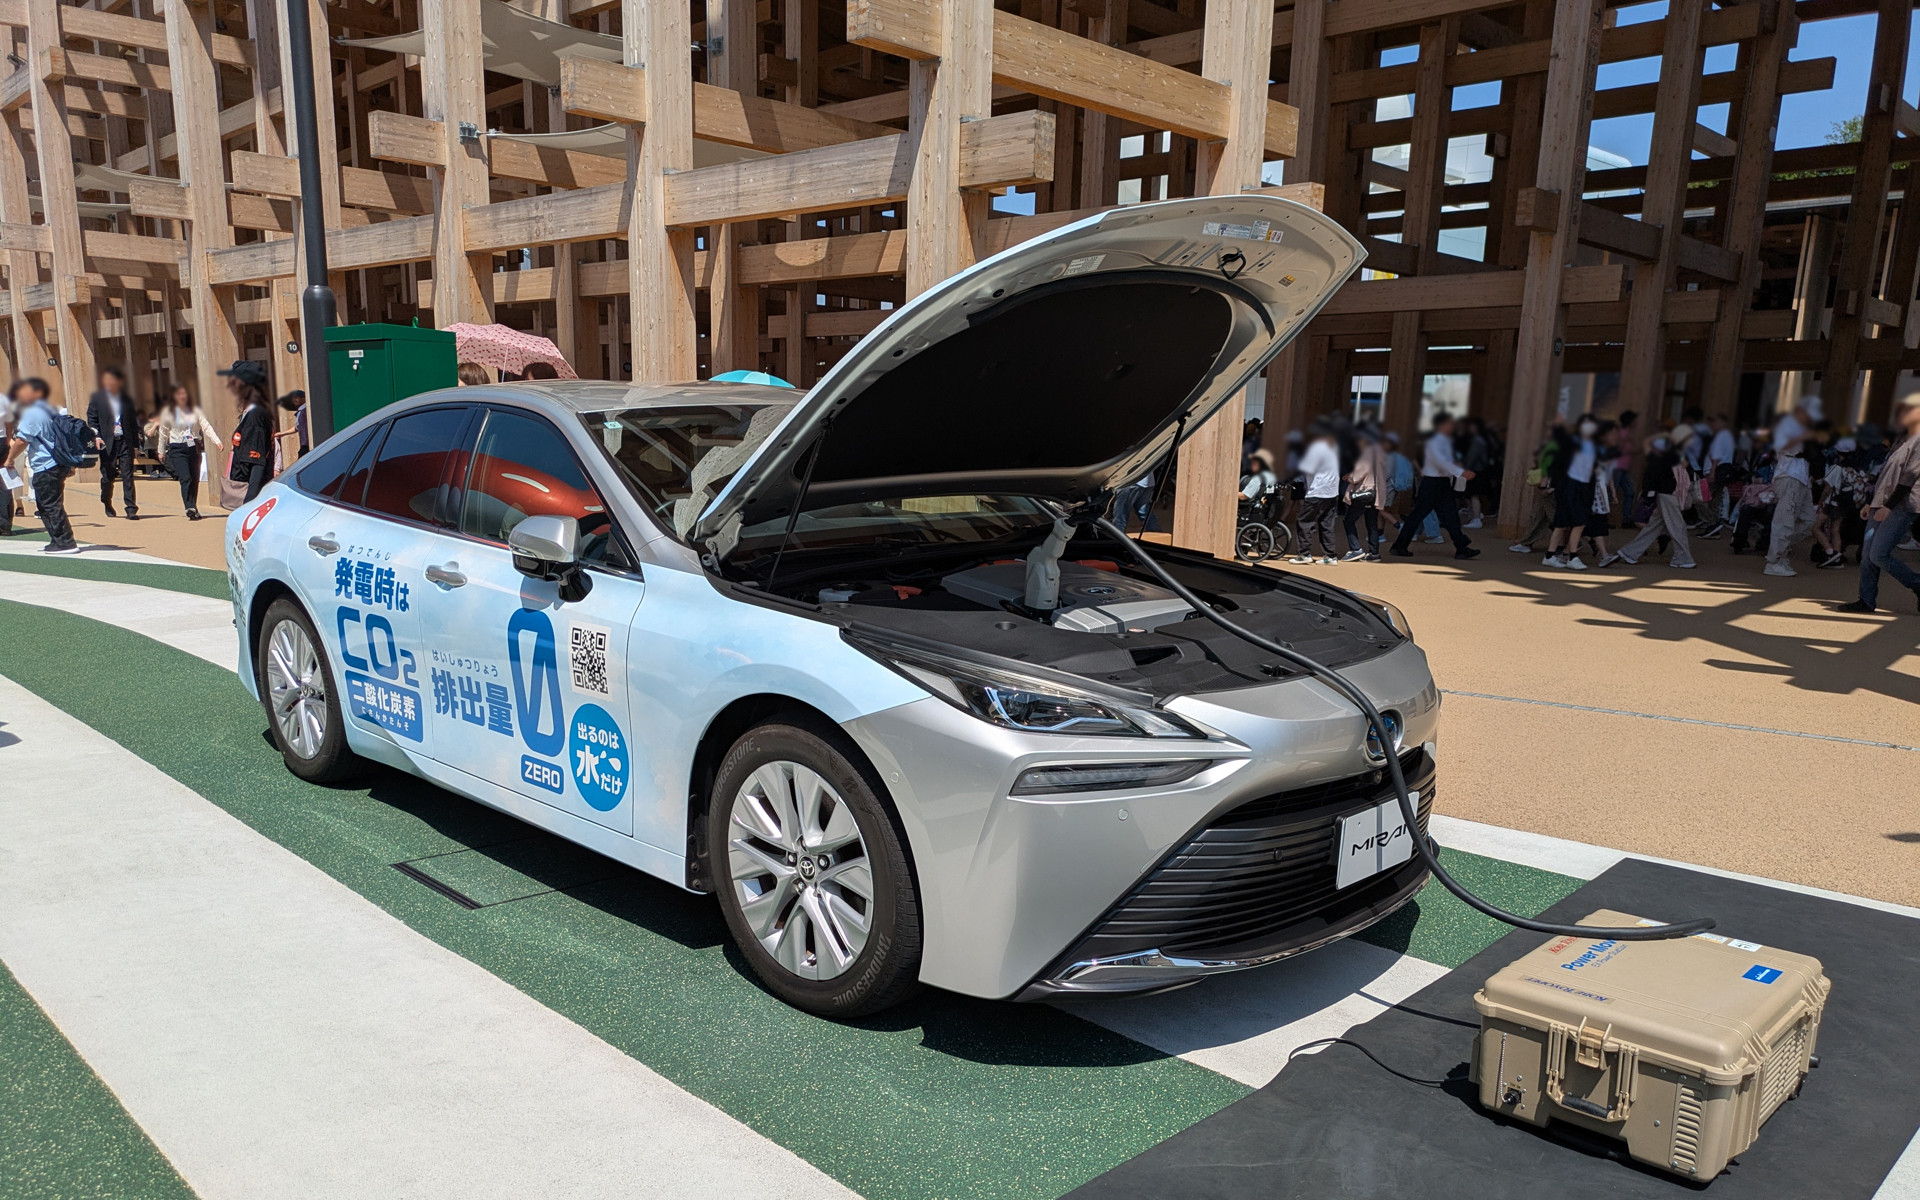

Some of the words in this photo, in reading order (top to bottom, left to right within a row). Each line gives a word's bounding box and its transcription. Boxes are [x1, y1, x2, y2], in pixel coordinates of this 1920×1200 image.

[348, 544, 392, 561] はつてんじ
[335, 556, 410, 612] 発電時は
[432, 649, 499, 678] はいしゅつりょう
[351, 679, 416, 721] 二酸化炭素
[431, 666, 515, 738] 排出量
[361, 705, 410, 732] にさんかたんそ
[577, 721, 620, 750] 出るのは
[524, 760, 561, 789] ZERO
[710, 736, 755, 819] BRIDGESTONE
[1351, 823, 1408, 856] MIRAI
[832, 932, 892, 1006] BRIDGESTONE
[1561, 951, 1599, 971] Power
[1588, 938, 1617, 953] Mov
[1575, 990, 1608, 1001] KOBE
